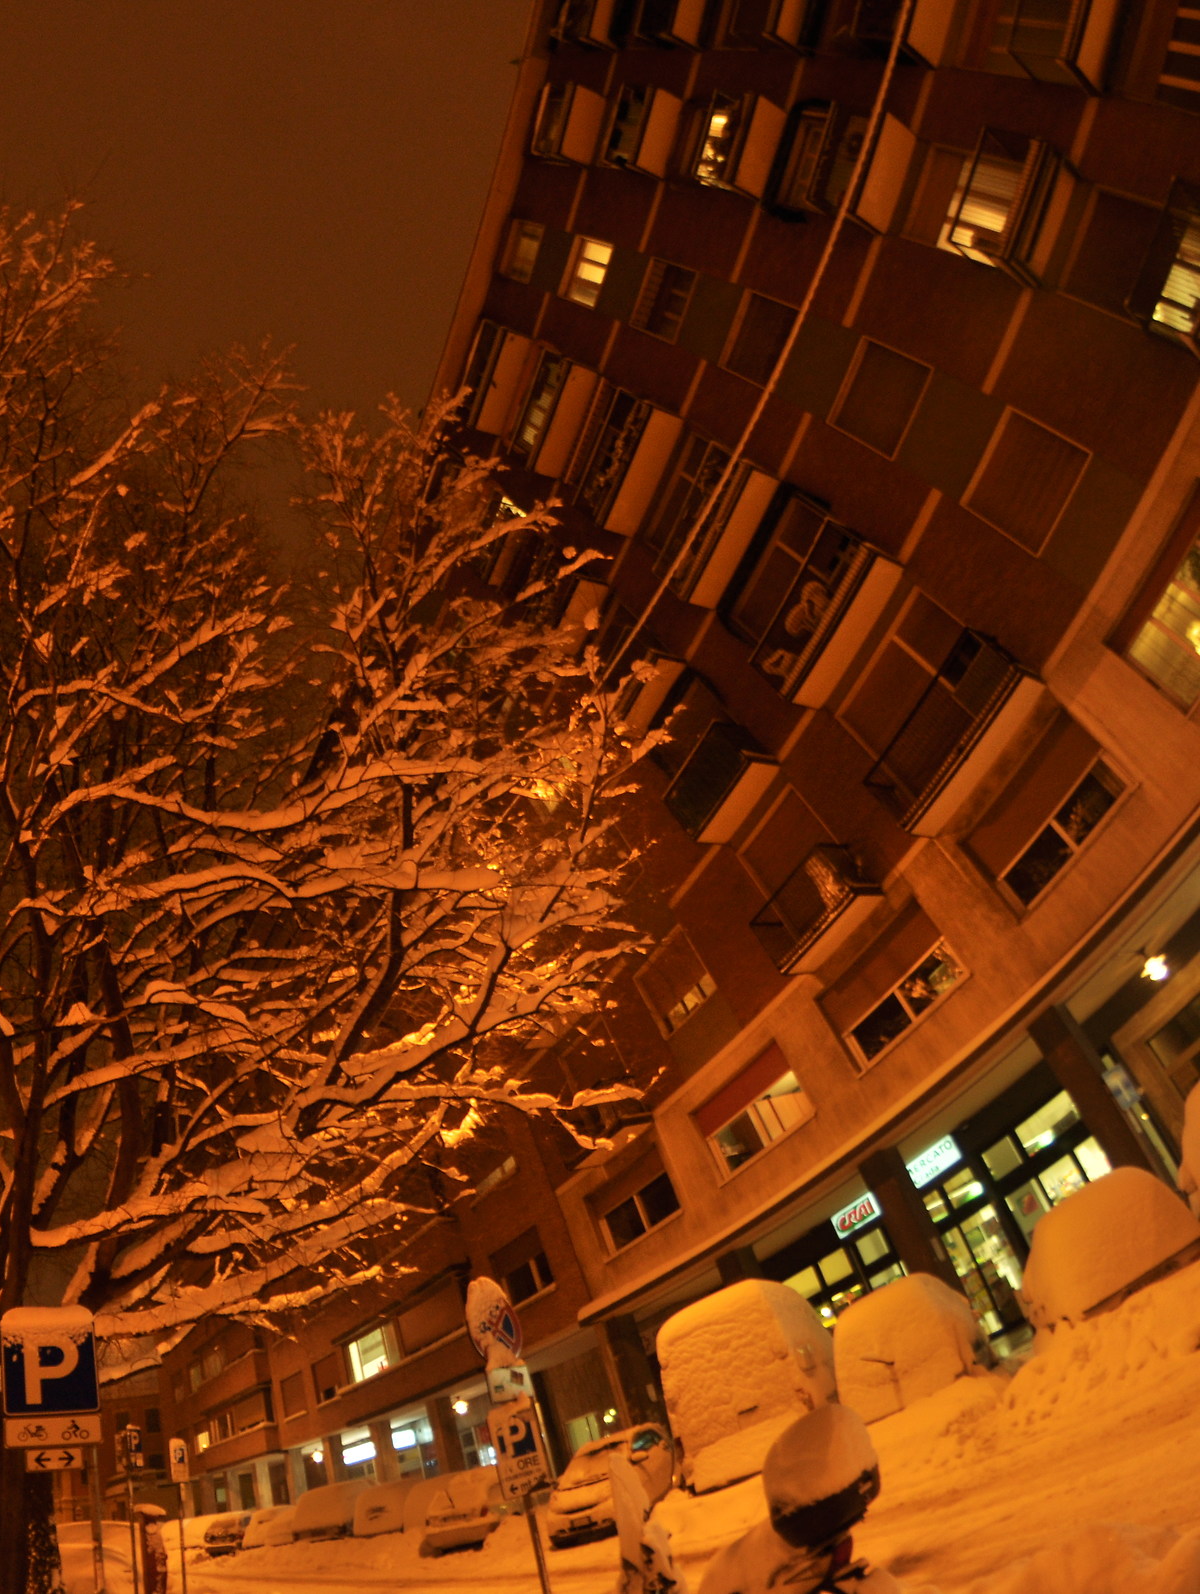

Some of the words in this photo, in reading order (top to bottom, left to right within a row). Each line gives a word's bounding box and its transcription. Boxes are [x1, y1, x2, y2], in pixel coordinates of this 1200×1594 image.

[837, 1199, 874, 1231] CRAI
[22, 1335, 79, 1405] P
[498, 1417, 527, 1458] P
[517, 1455, 540, 1471] ORE
